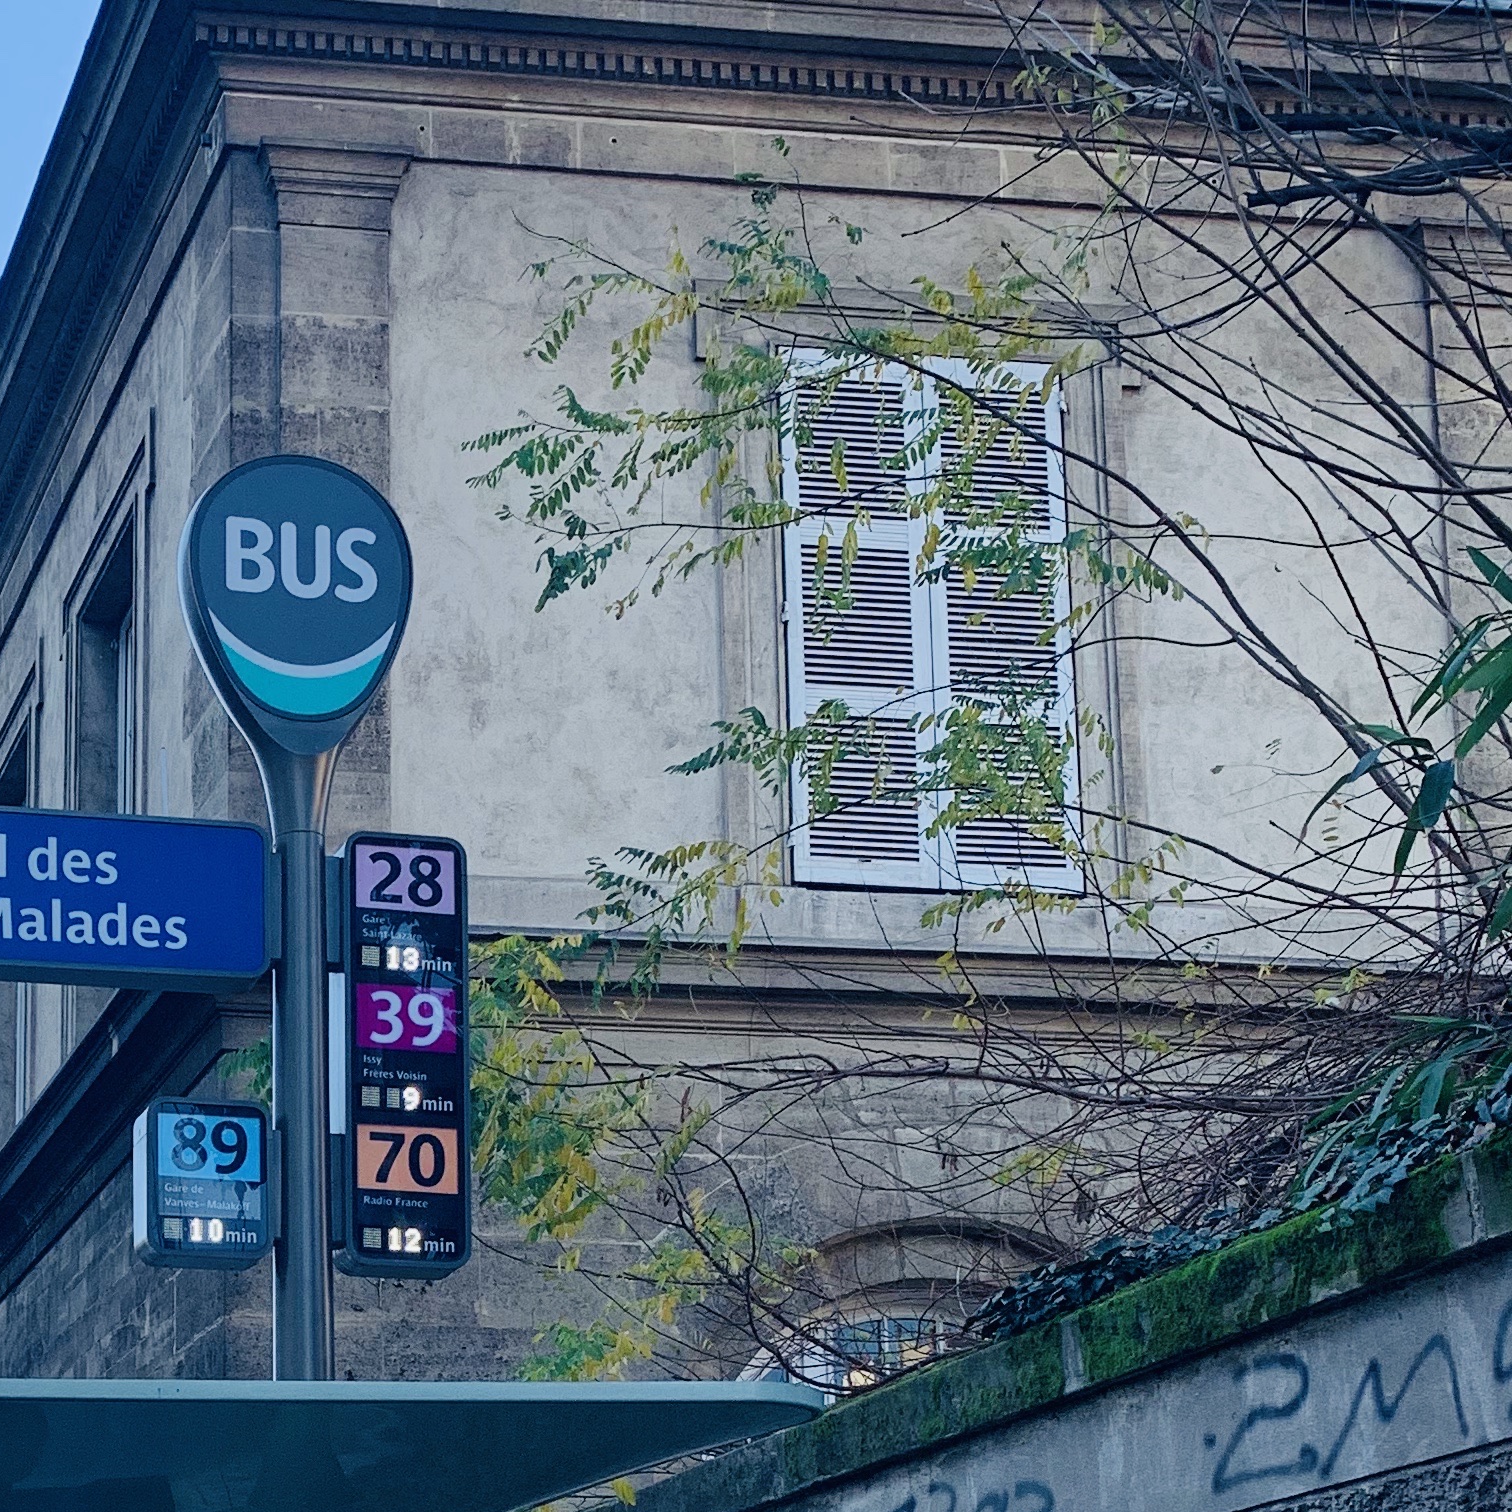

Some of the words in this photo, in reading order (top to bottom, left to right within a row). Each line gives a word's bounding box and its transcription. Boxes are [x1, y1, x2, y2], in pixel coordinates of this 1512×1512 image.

[225, 515, 378, 603] BUS
[27, 835, 118, 885] des
[369, 851, 443, 907] 28
[362, 914, 386, 924] Gare
[421, 957, 452, 972] min
[369, 990, 444, 1046] 39
[363, 1054, 382, 1066] Issy
[363, 1068, 394, 1079] Frères
[396, 1070, 428, 1081] Voisin
[422, 1097, 454, 1112] min
[171, 1117, 248, 1175] 89
[369, 1131, 445, 1187] 70
[164, 1182, 189, 1194] Gare
[190, 1183, 204, 1194] de
[164, 1197, 200, 1209] Vanves
[363, 1195, 392, 1206] Radio
[395, 1197, 429, 1208] France
[189, 1217, 224, 1243] 10
[225, 1228, 257, 1243] min
[387, 1226, 422, 1253] 12
[424, 1237, 456, 1253] min
